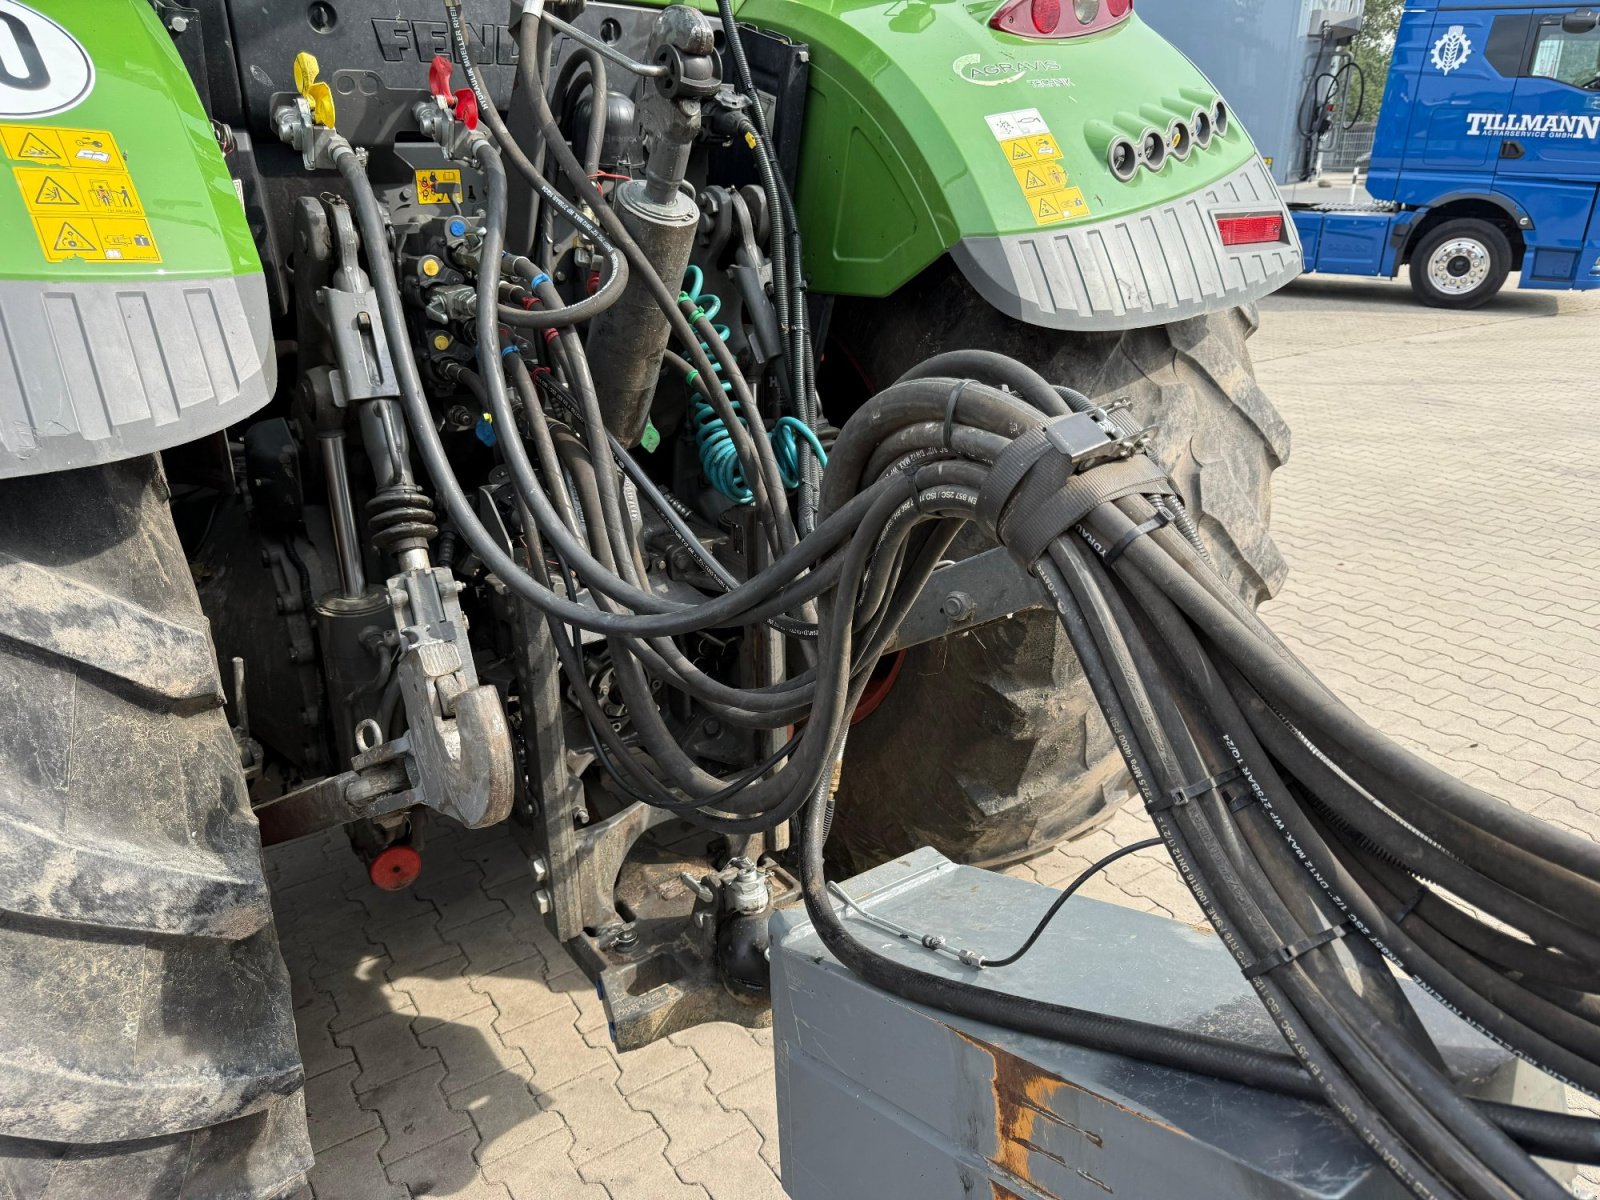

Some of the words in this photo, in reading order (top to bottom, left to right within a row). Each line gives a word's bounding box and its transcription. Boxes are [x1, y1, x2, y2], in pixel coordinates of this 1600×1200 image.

[450, 8, 459, 28] RHEI
[371, 17, 571, 67] FEND
[455, 29, 471, 67] MUELLER
[970, 60, 1061, 79] AGRAVIS
[466, 66, 489, 113] HYDRAULIK
[1466, 113, 1600, 139] TILLMANN
[1482, 129, 1546, 138] AGRARSERVICE
[924, 491, 937, 501] ISO
[941, 490, 955, 499] 2SC
[955, 491, 967, 502] 857
[967, 495, 977, 504] EN
[1117, 733, 1134, 758] (4000
[1220, 731, 1245, 765] 1Q/24
[1128, 757, 1143, 778] MPa
[1138, 777, 1152, 798] 27.5
[1240, 764, 1273, 811] 275BAR
[1268, 809, 1286, 831] WP
[1281, 830, 1307, 861] MAX.
[1171, 846, 1190, 873] DN12
[1301, 859, 1330, 890] DN12
[1184, 873, 1210, 907] 100R16
[1205, 905, 1224, 928] SAE
[1346, 912, 1370, 936] 2SC
[1223, 931, 1240, 950] R16
[1368, 934, 1405, 969] EN857
[1265, 995, 1281, 1015] ISO
[1279, 1019, 1298, 1041] 2SC
